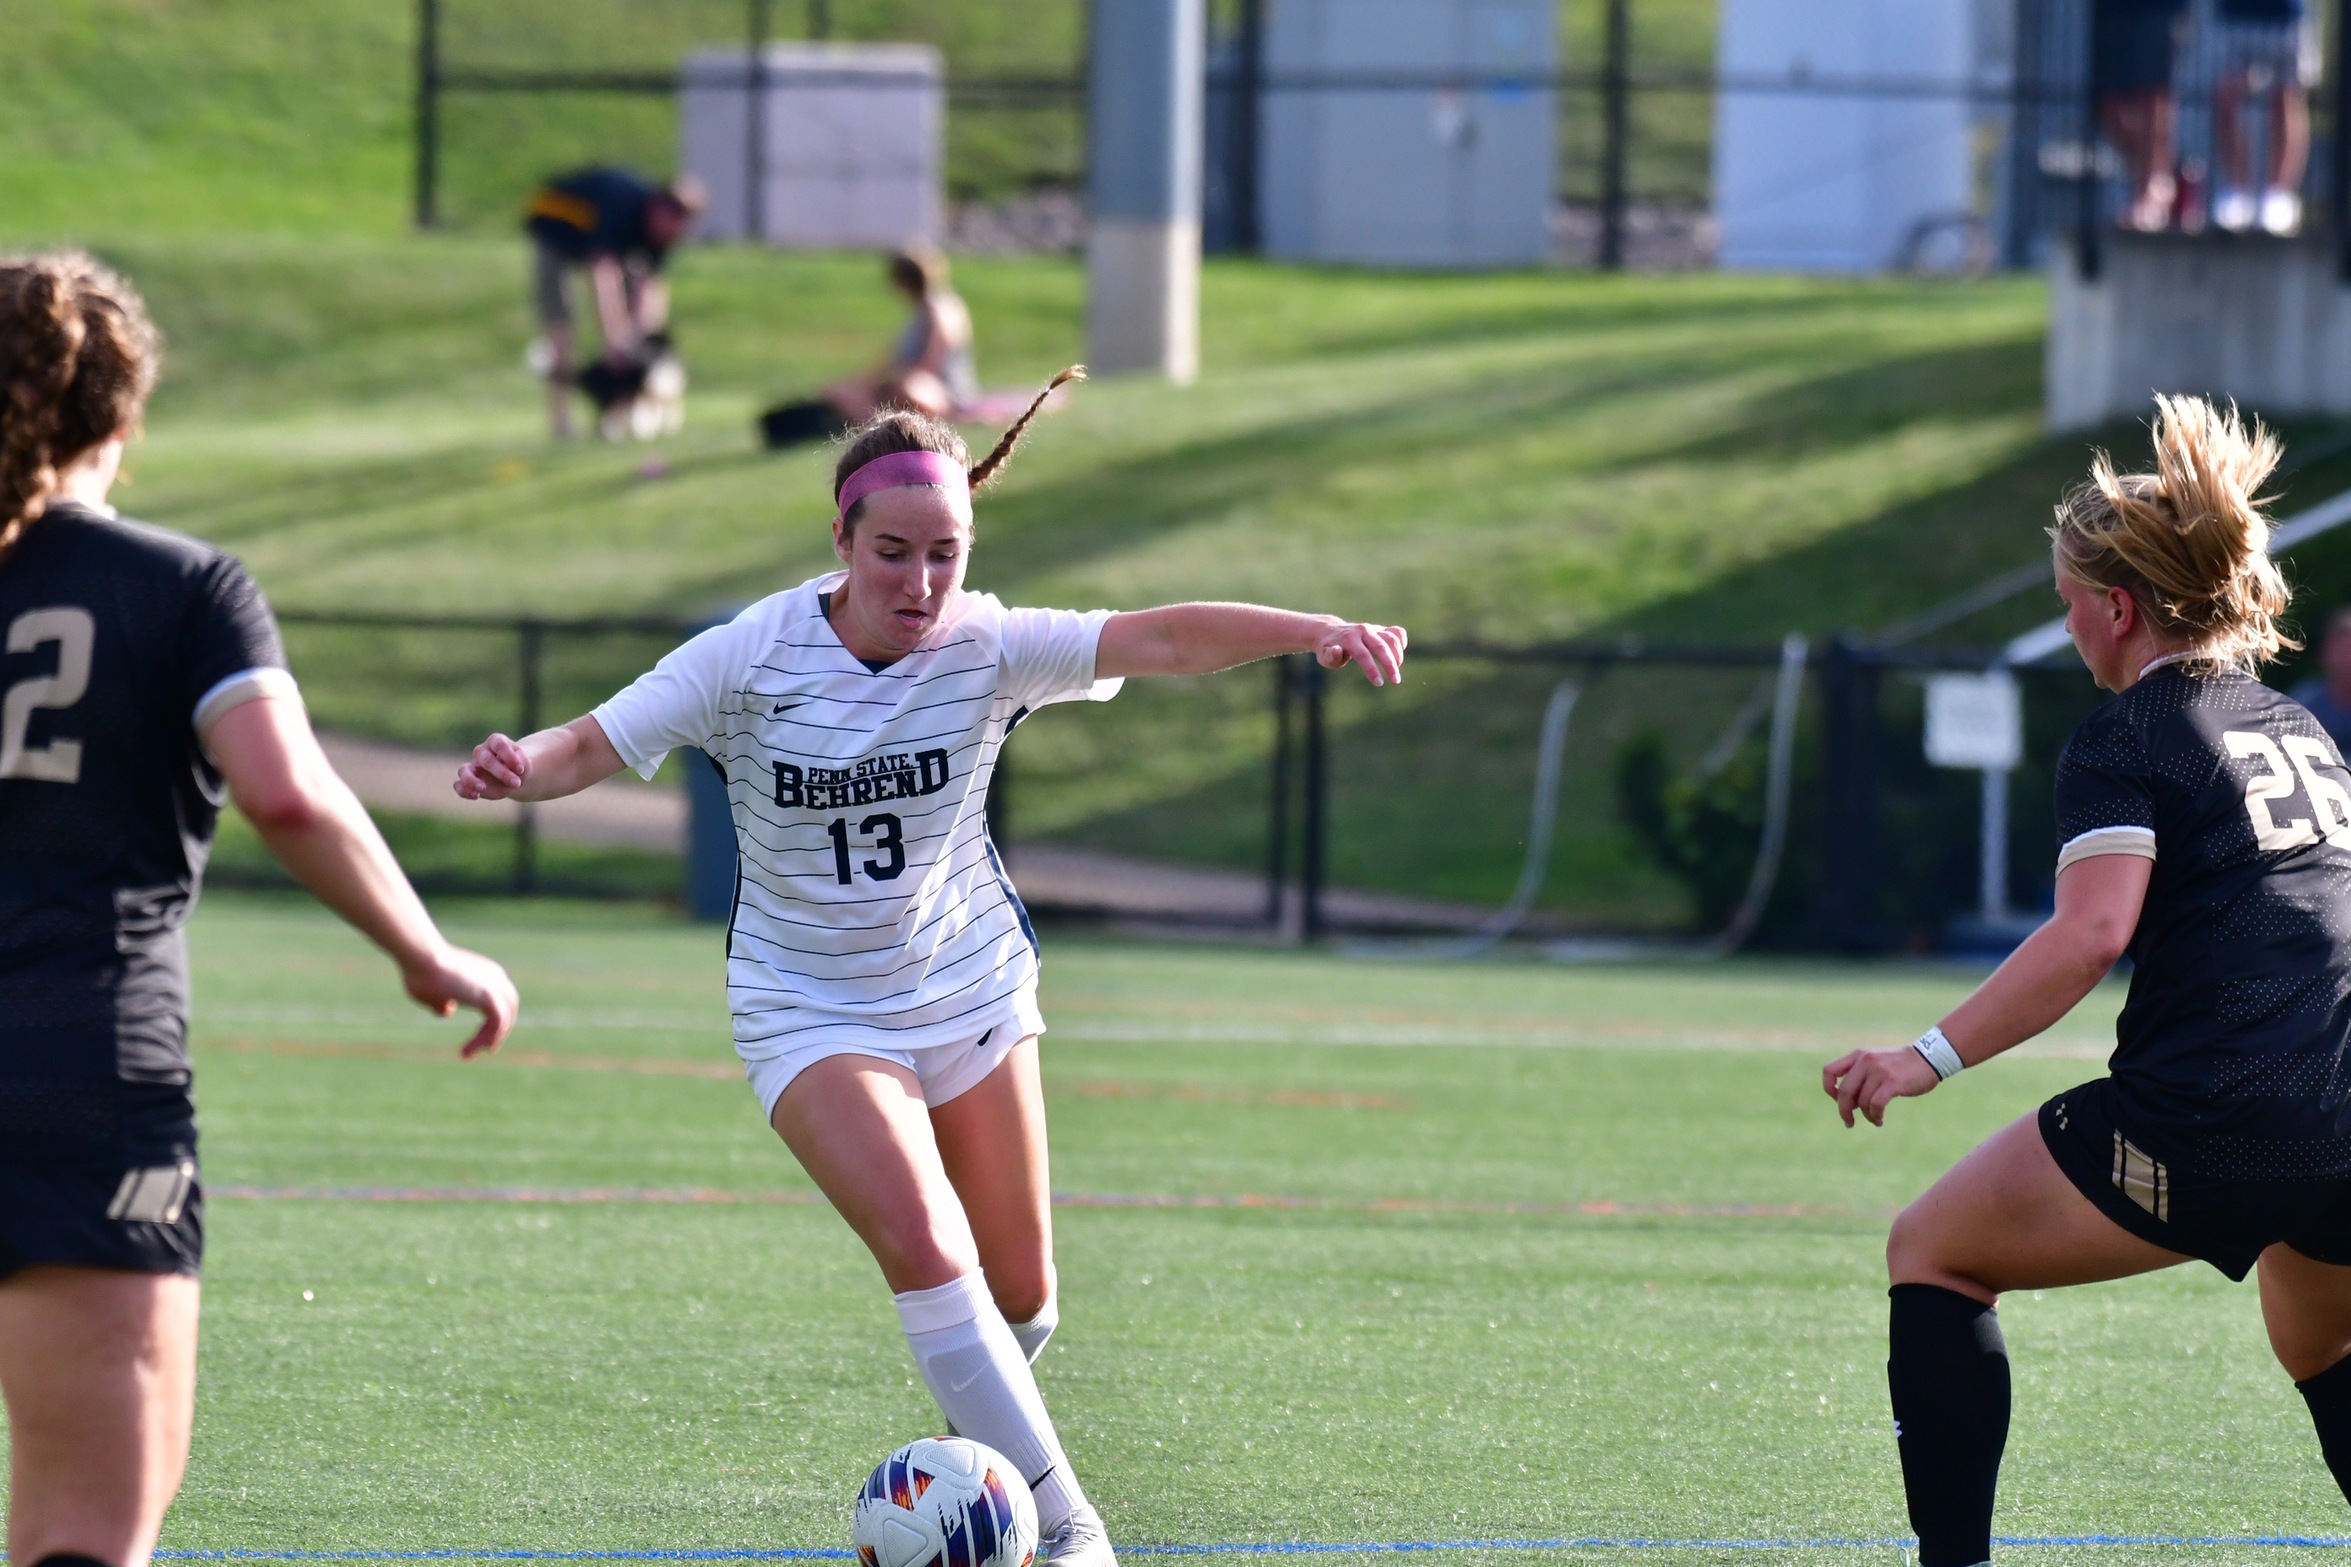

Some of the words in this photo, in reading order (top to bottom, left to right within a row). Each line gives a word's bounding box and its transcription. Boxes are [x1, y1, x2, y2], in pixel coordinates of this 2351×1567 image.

[0, 605, 95, 784] 2
[772, 748, 948, 811] BEHREND
[808, 767, 852, 784] PENN
[857, 753, 910, 777] STATE
[2223, 731, 2351, 852] 26
[828, 812, 906, 885] 13
